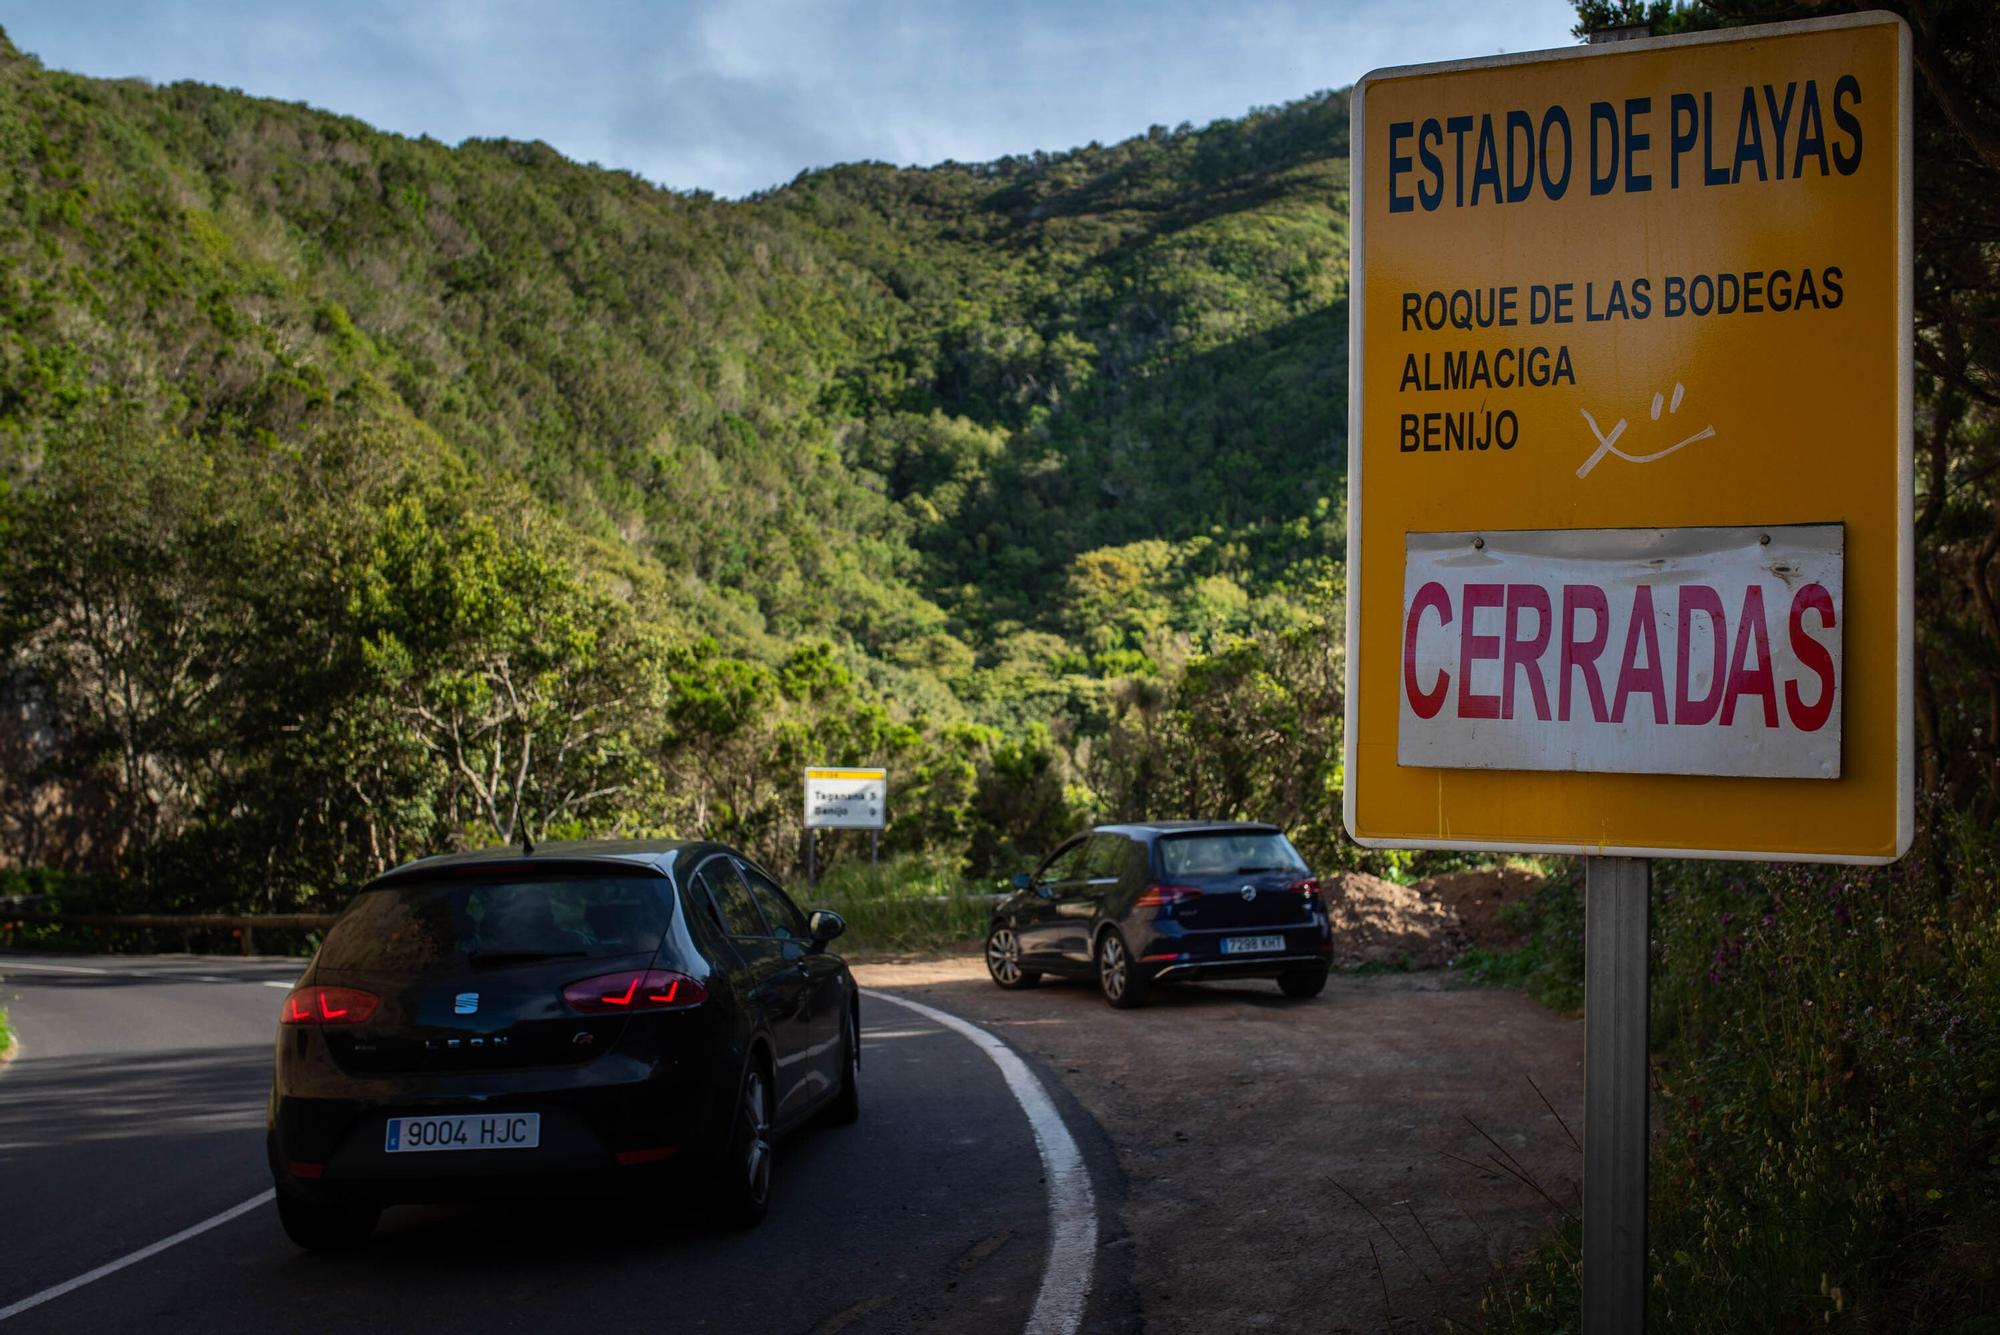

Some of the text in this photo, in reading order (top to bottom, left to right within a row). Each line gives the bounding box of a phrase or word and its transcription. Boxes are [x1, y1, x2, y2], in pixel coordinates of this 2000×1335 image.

[1389, 74, 1864, 213] ESTADO DE PLAYAS
[1401, 266, 1844, 332] ROQUE DE LAS BODEGAS
[1400, 345, 1577, 393] ALMACIGA
[1400, 409, 1519, 453] BENIJO
[1403, 581, 1837, 732] CERRADAS
[408, 1120, 467, 1146] 9004
[480, 1118, 527, 1144] HJC
